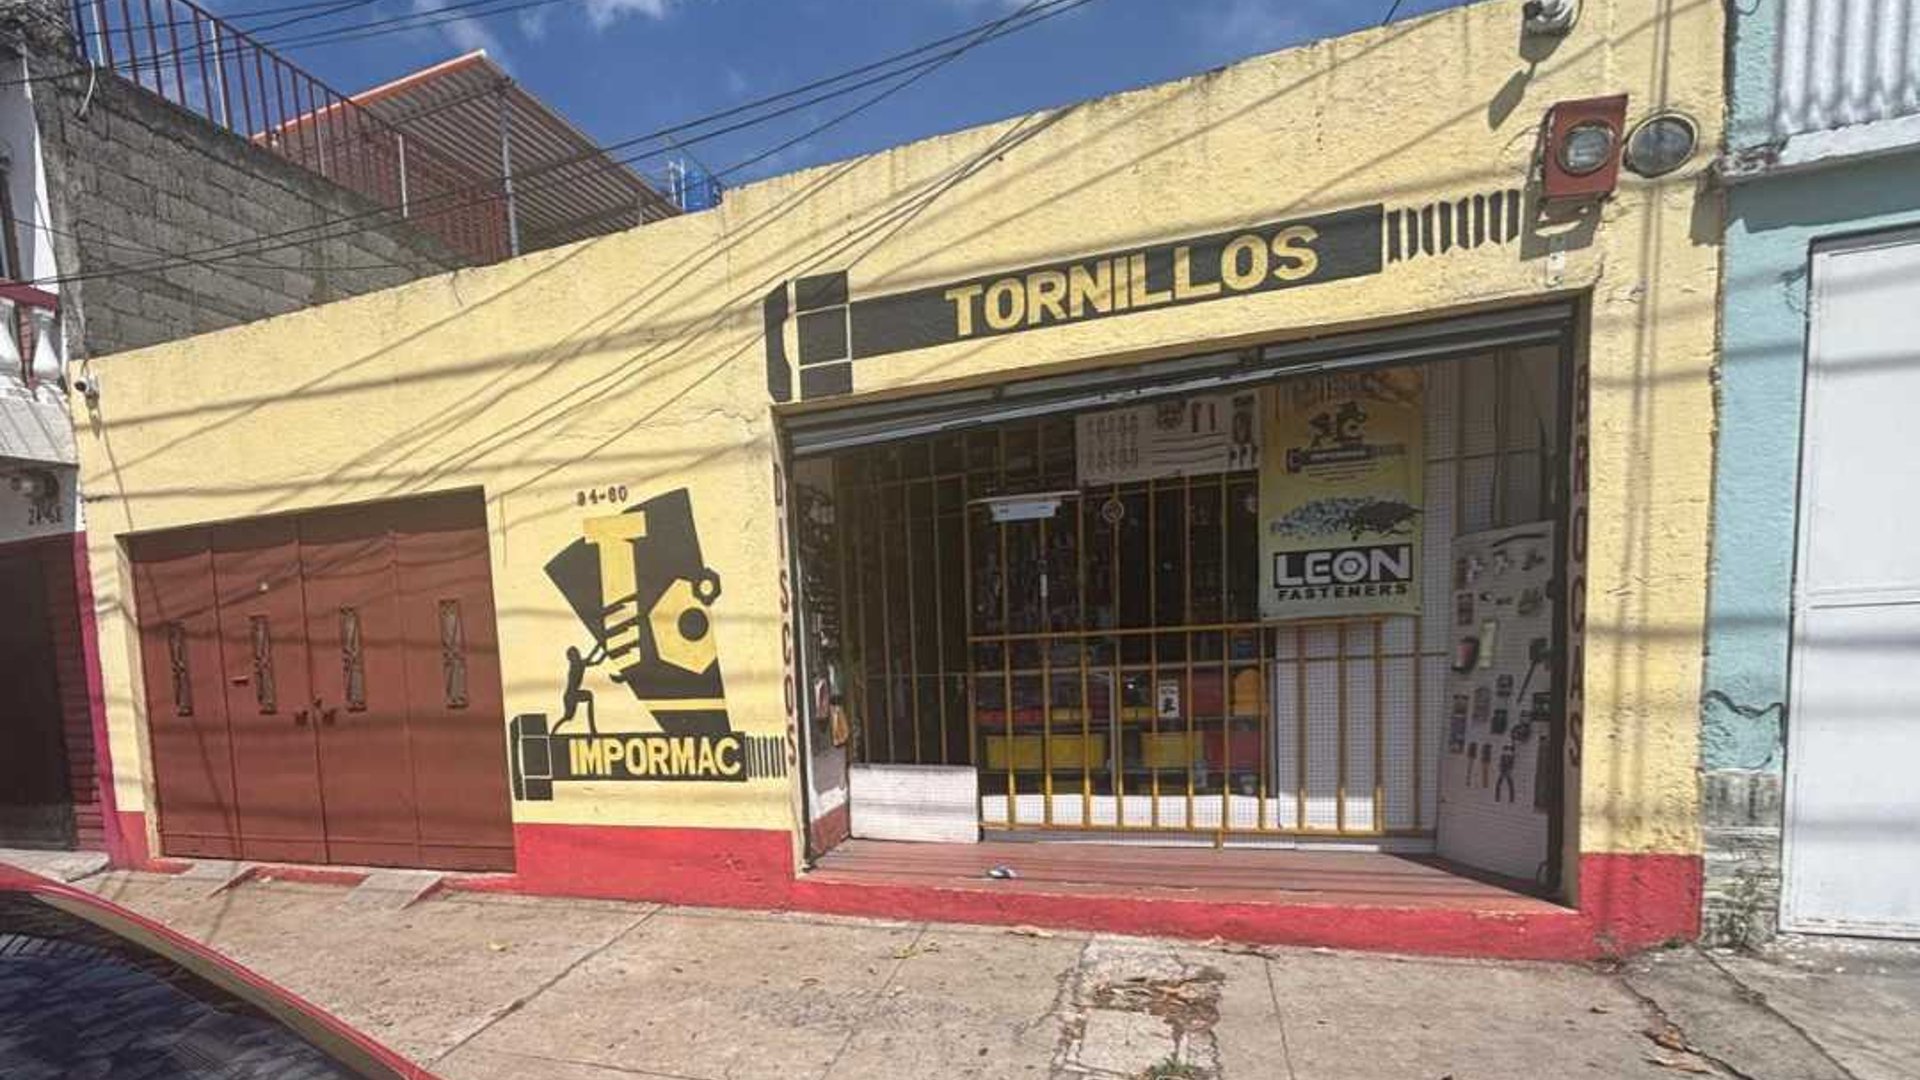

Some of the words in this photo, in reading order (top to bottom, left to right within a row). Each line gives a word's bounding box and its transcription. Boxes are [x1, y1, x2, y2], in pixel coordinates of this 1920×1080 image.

[945, 226, 1319, 337] TORNILLOS
[1276, 547, 1410, 586] LEON
[1278, 583, 1408, 600] FASTENERS
[1569, 363, 1588, 767] BROCAS
[773, 461, 796, 767] DISCOS
[570, 738, 742, 775] IMPORMAC
